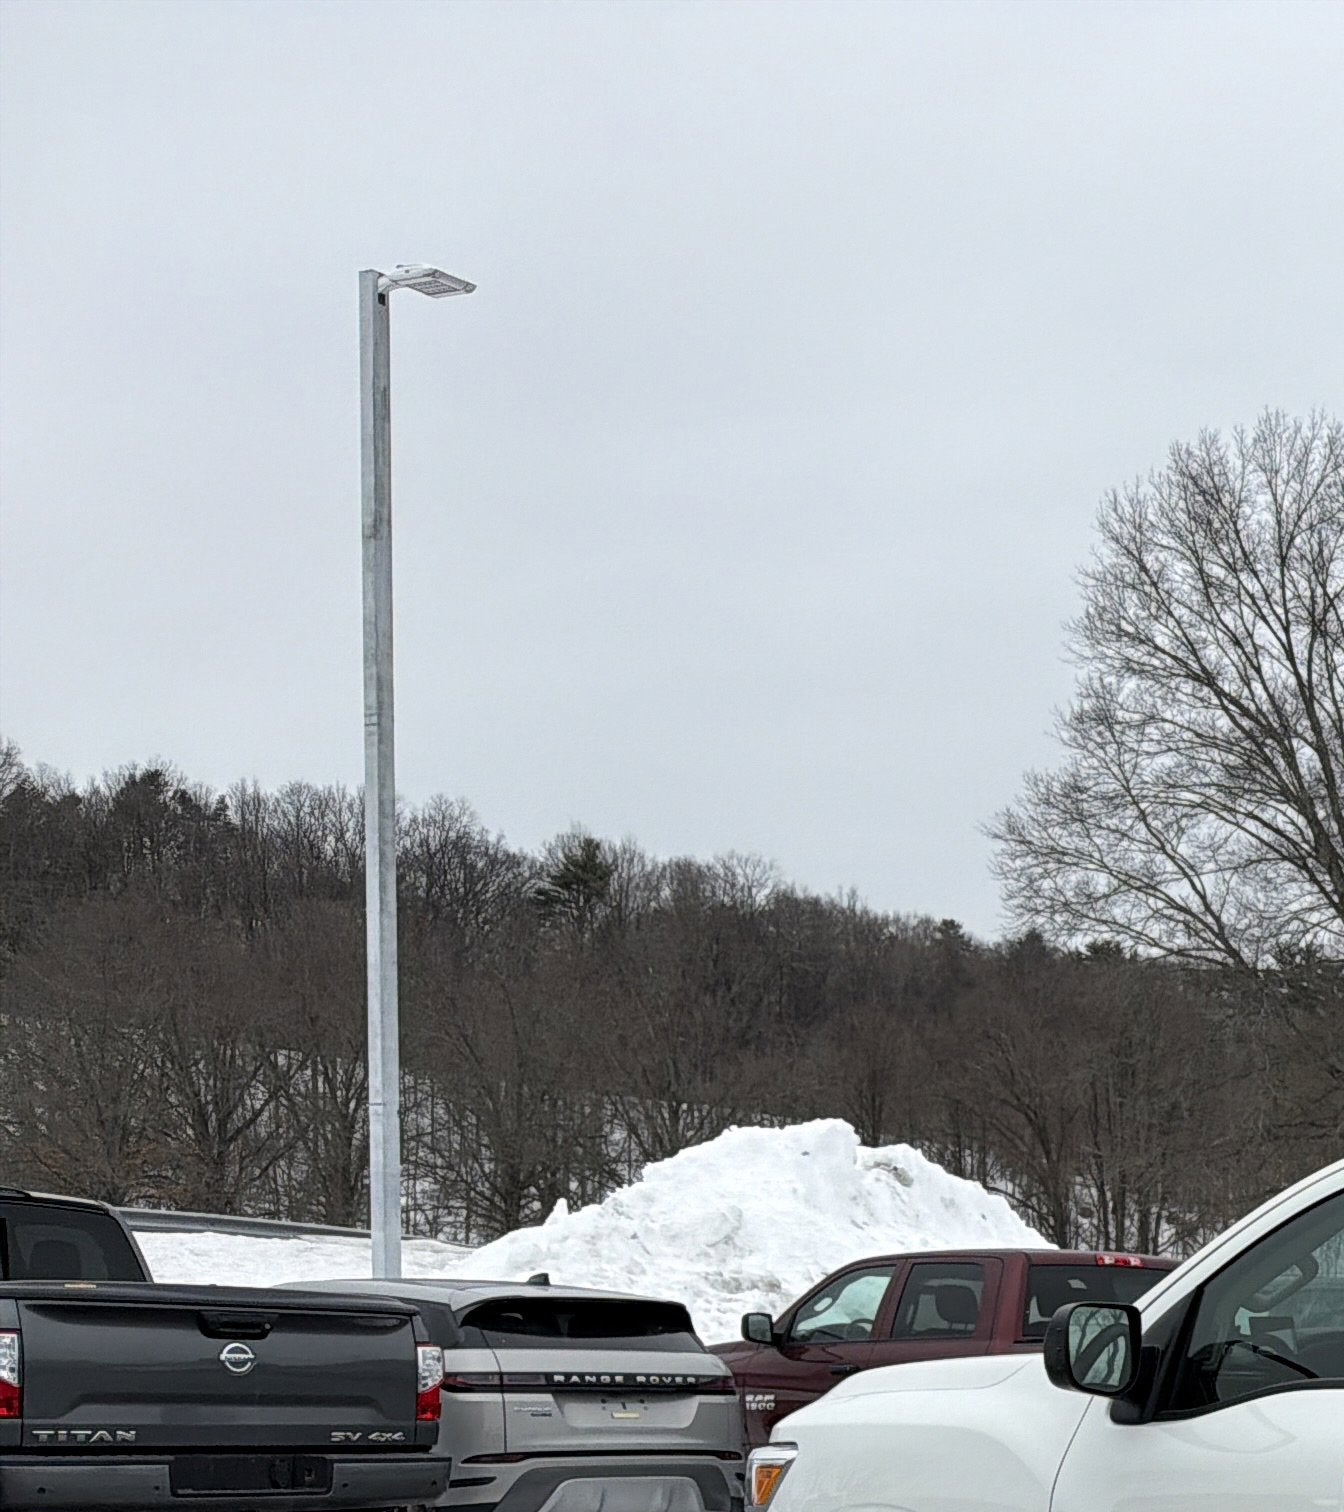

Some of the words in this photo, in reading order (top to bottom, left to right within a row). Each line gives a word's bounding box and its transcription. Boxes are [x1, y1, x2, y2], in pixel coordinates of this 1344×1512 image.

[553, 1374, 625, 1384] RANGE
[635, 1375, 697, 1385] ROVER
[31, 1430, 137, 1443] TITAN
[330, 1431, 363, 1442] SV
